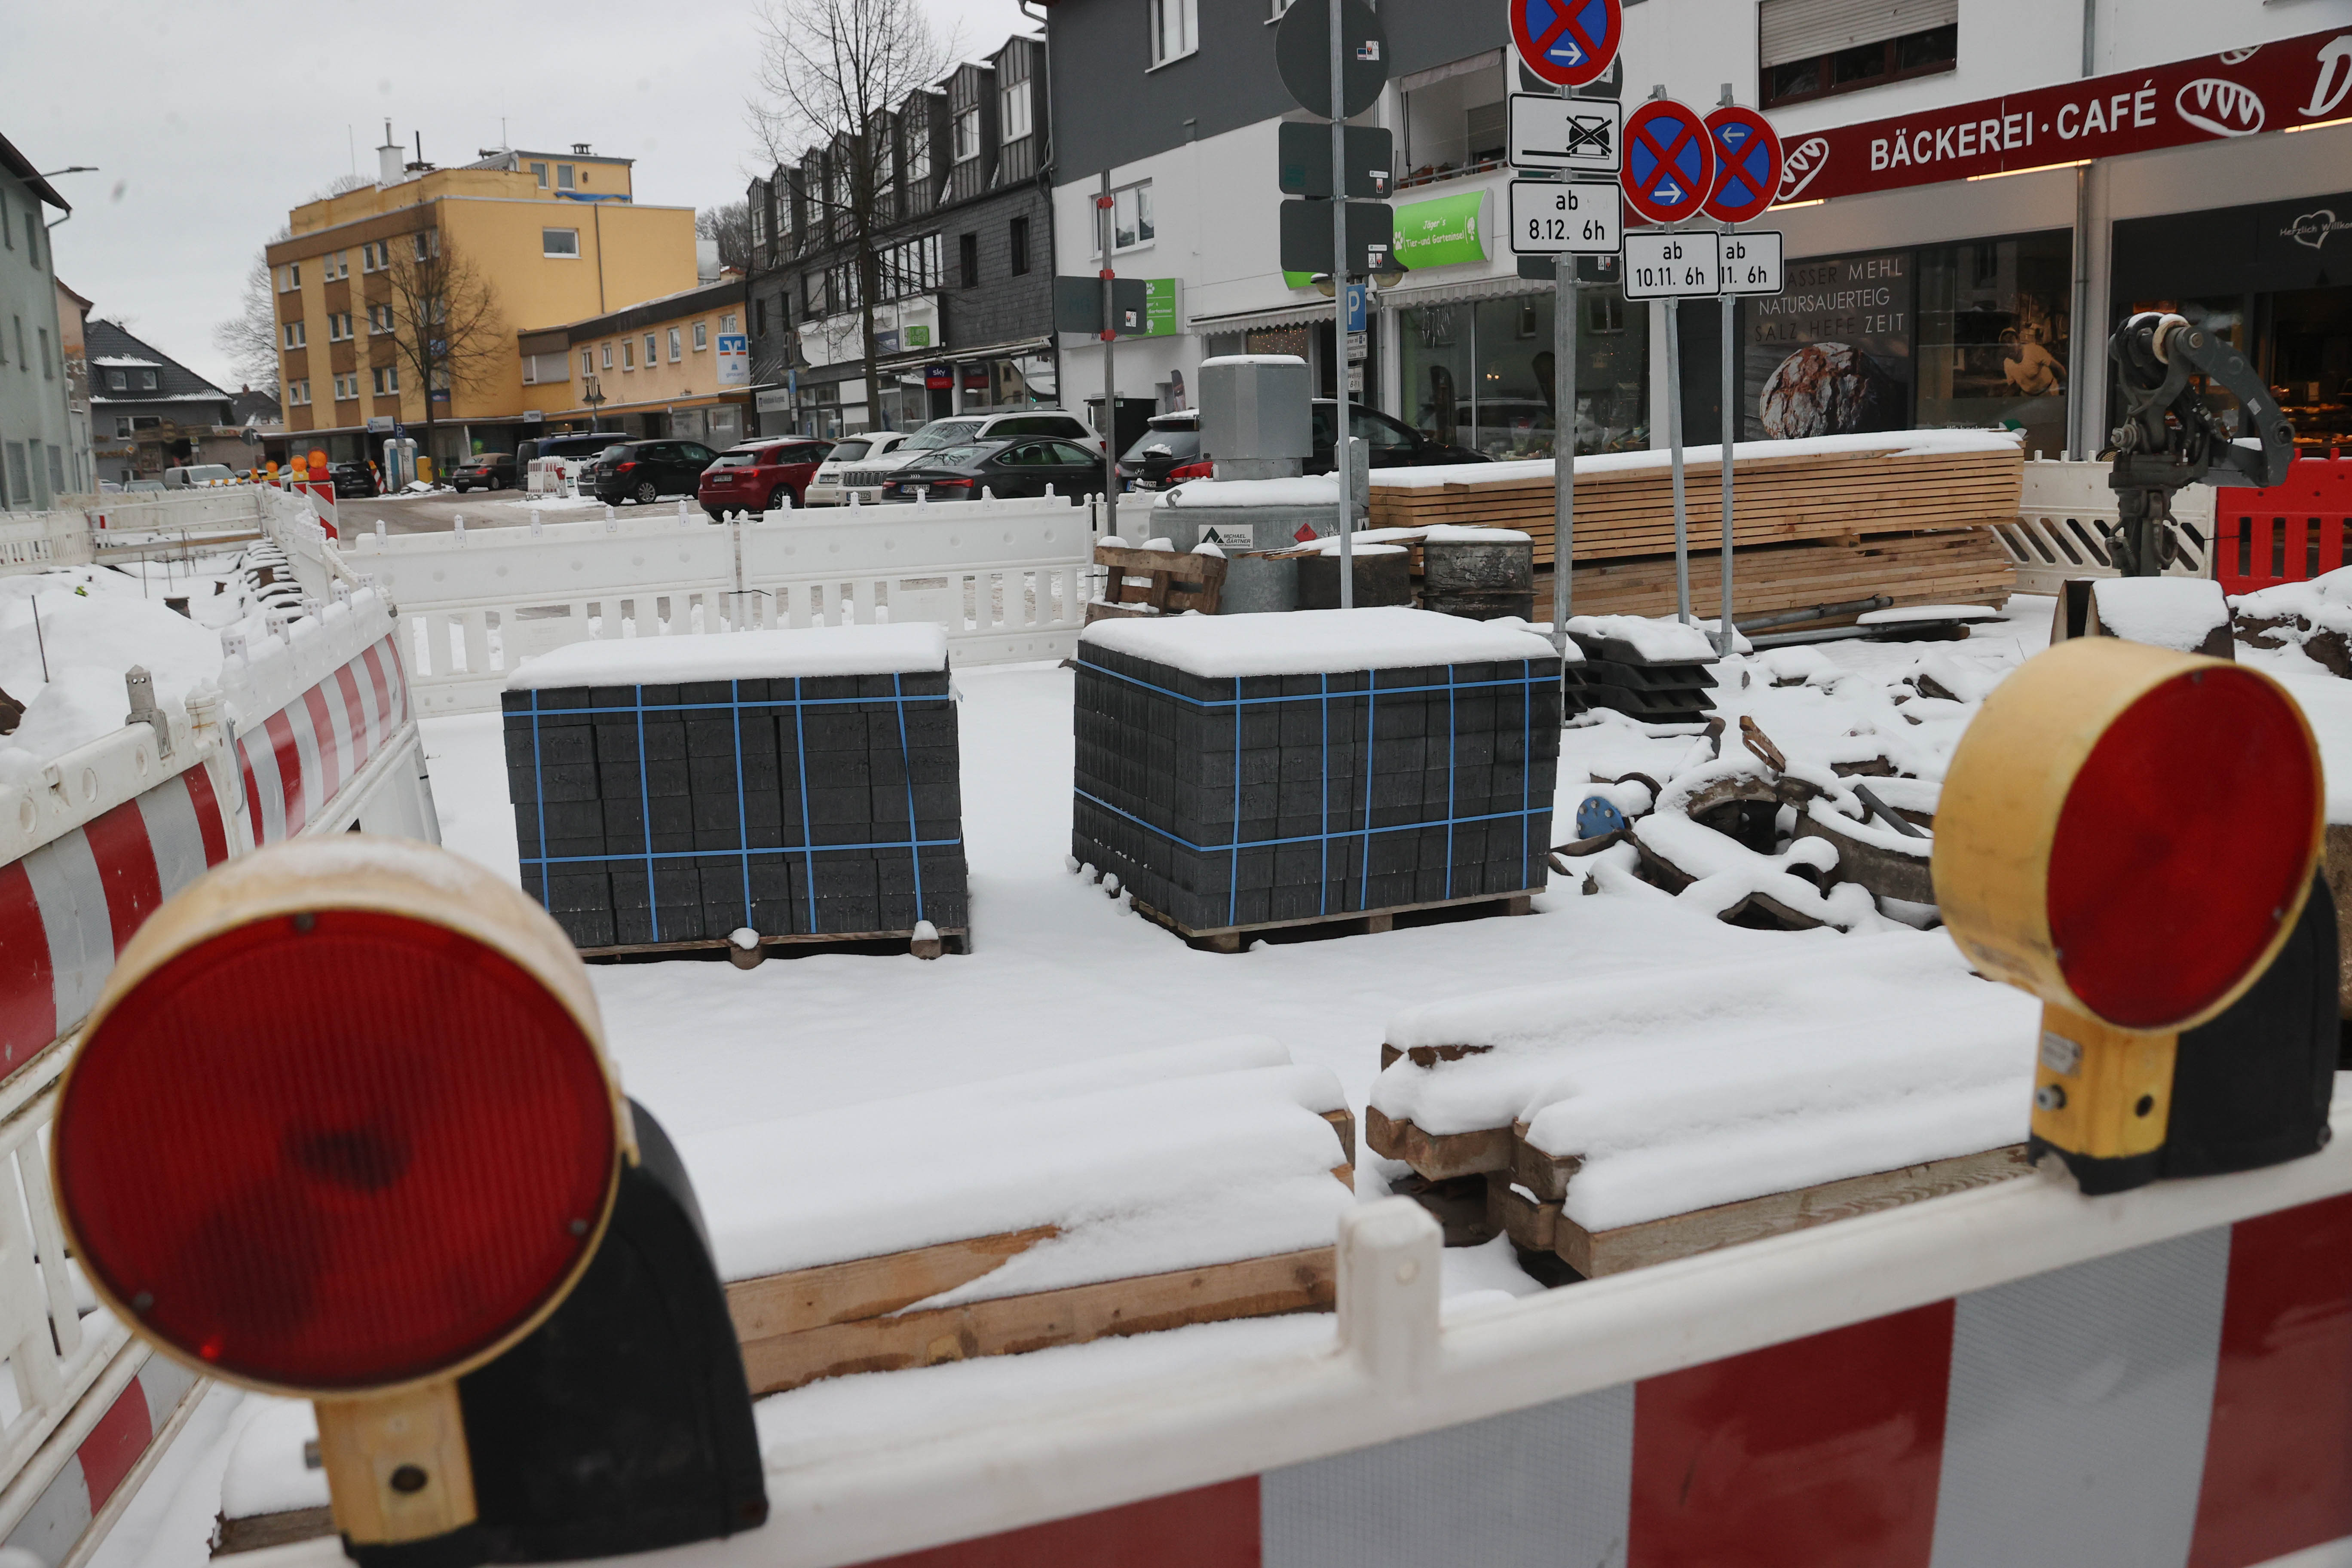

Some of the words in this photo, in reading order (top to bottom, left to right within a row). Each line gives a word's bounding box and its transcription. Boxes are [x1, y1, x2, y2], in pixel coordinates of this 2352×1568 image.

[1871, 111, 2033, 171] BÄCKEREI
[2057, 79, 2156, 140] CAFÉ
[1556, 190, 1578, 210] ab
[1432, 229, 1464, 244] Garteninsel
[1529, 219, 1570, 240] 8.12.
[1583, 220, 1605, 240] 6h
[2280, 225, 2318, 236] Herzlich
[1663, 241, 1682, 260] ab
[1726, 242, 1745, 259] ab
[1636, 267, 1676, 287] 10.11.
[1685, 266, 1704, 285] 6h
[1748, 266, 1767, 283] 6h
[1786, 266, 1837, 288] ASSER
[1849, 258, 1903, 281] MEHL
[1348, 291, 1360, 325] P
[1759, 287, 1890, 316] NATURSAUERTEIG
[1755, 323, 1797, 342] SALZ
[1810, 316, 1856, 337] HEFE
[1865, 313, 1904, 334] ZEIT
[933, 368, 946, 378] sky
